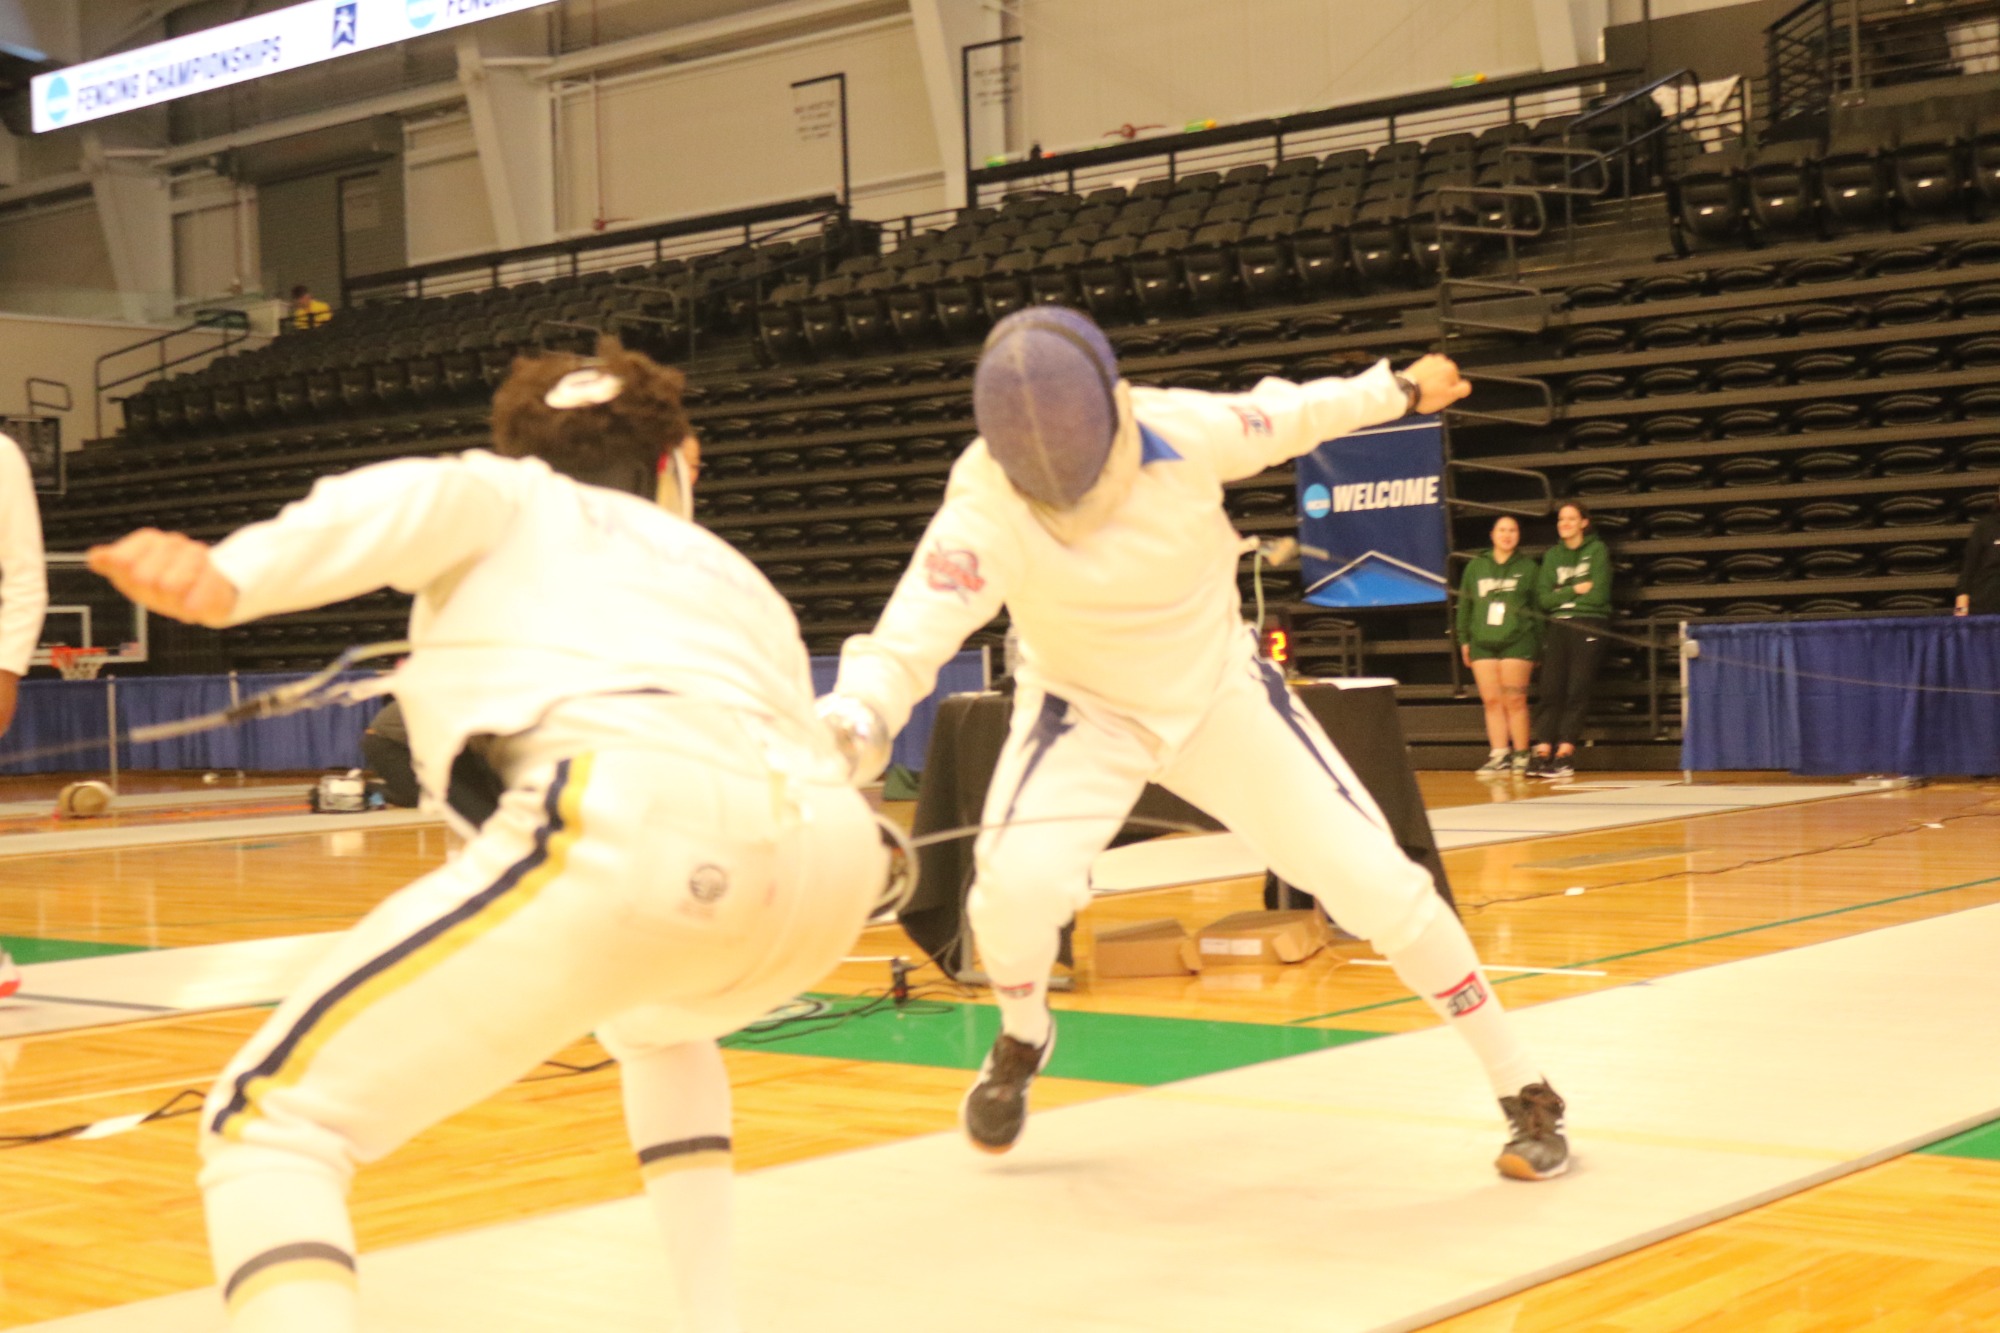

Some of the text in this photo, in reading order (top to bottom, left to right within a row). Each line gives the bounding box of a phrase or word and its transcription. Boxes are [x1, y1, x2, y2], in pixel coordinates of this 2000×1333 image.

[77, 74, 140, 113] FENCING
[146, 35, 281, 95] CHAMPIONSHIPS
[1333, 475, 1440, 513] WELCOME
[1270, 630, 1288, 662] 2
